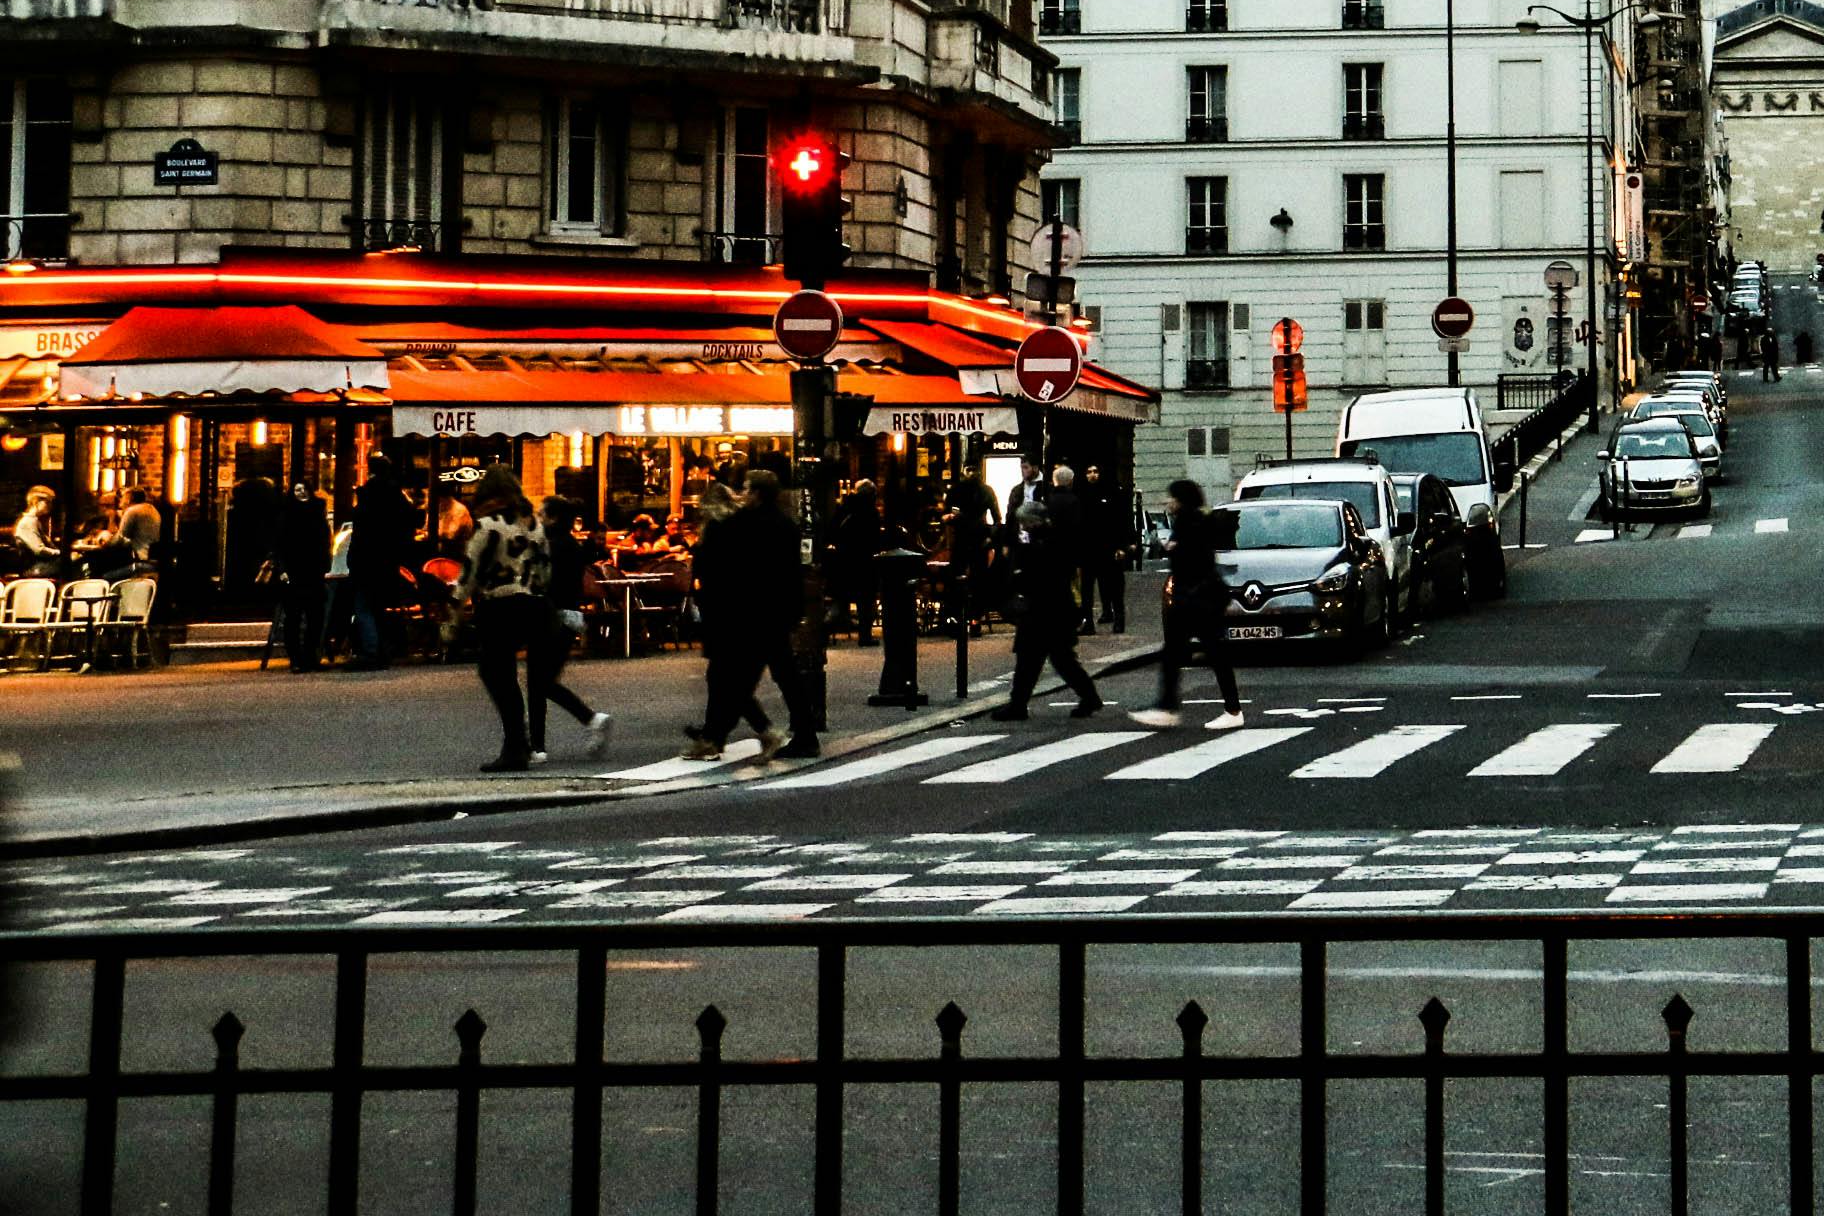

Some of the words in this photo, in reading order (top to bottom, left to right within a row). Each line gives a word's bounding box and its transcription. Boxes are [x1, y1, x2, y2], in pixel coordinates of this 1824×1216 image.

[168, 158, 207, 167] BOULEVARD
[160, 170, 179, 178] SAINT
[181, 169, 212, 177] GERMAIN
[702, 344, 763, 359] COCKTAILS
[433, 412, 476, 432] CAFE
[893, 413, 984, 431] RESTAURANT
[993, 442, 1018, 450] MENU
